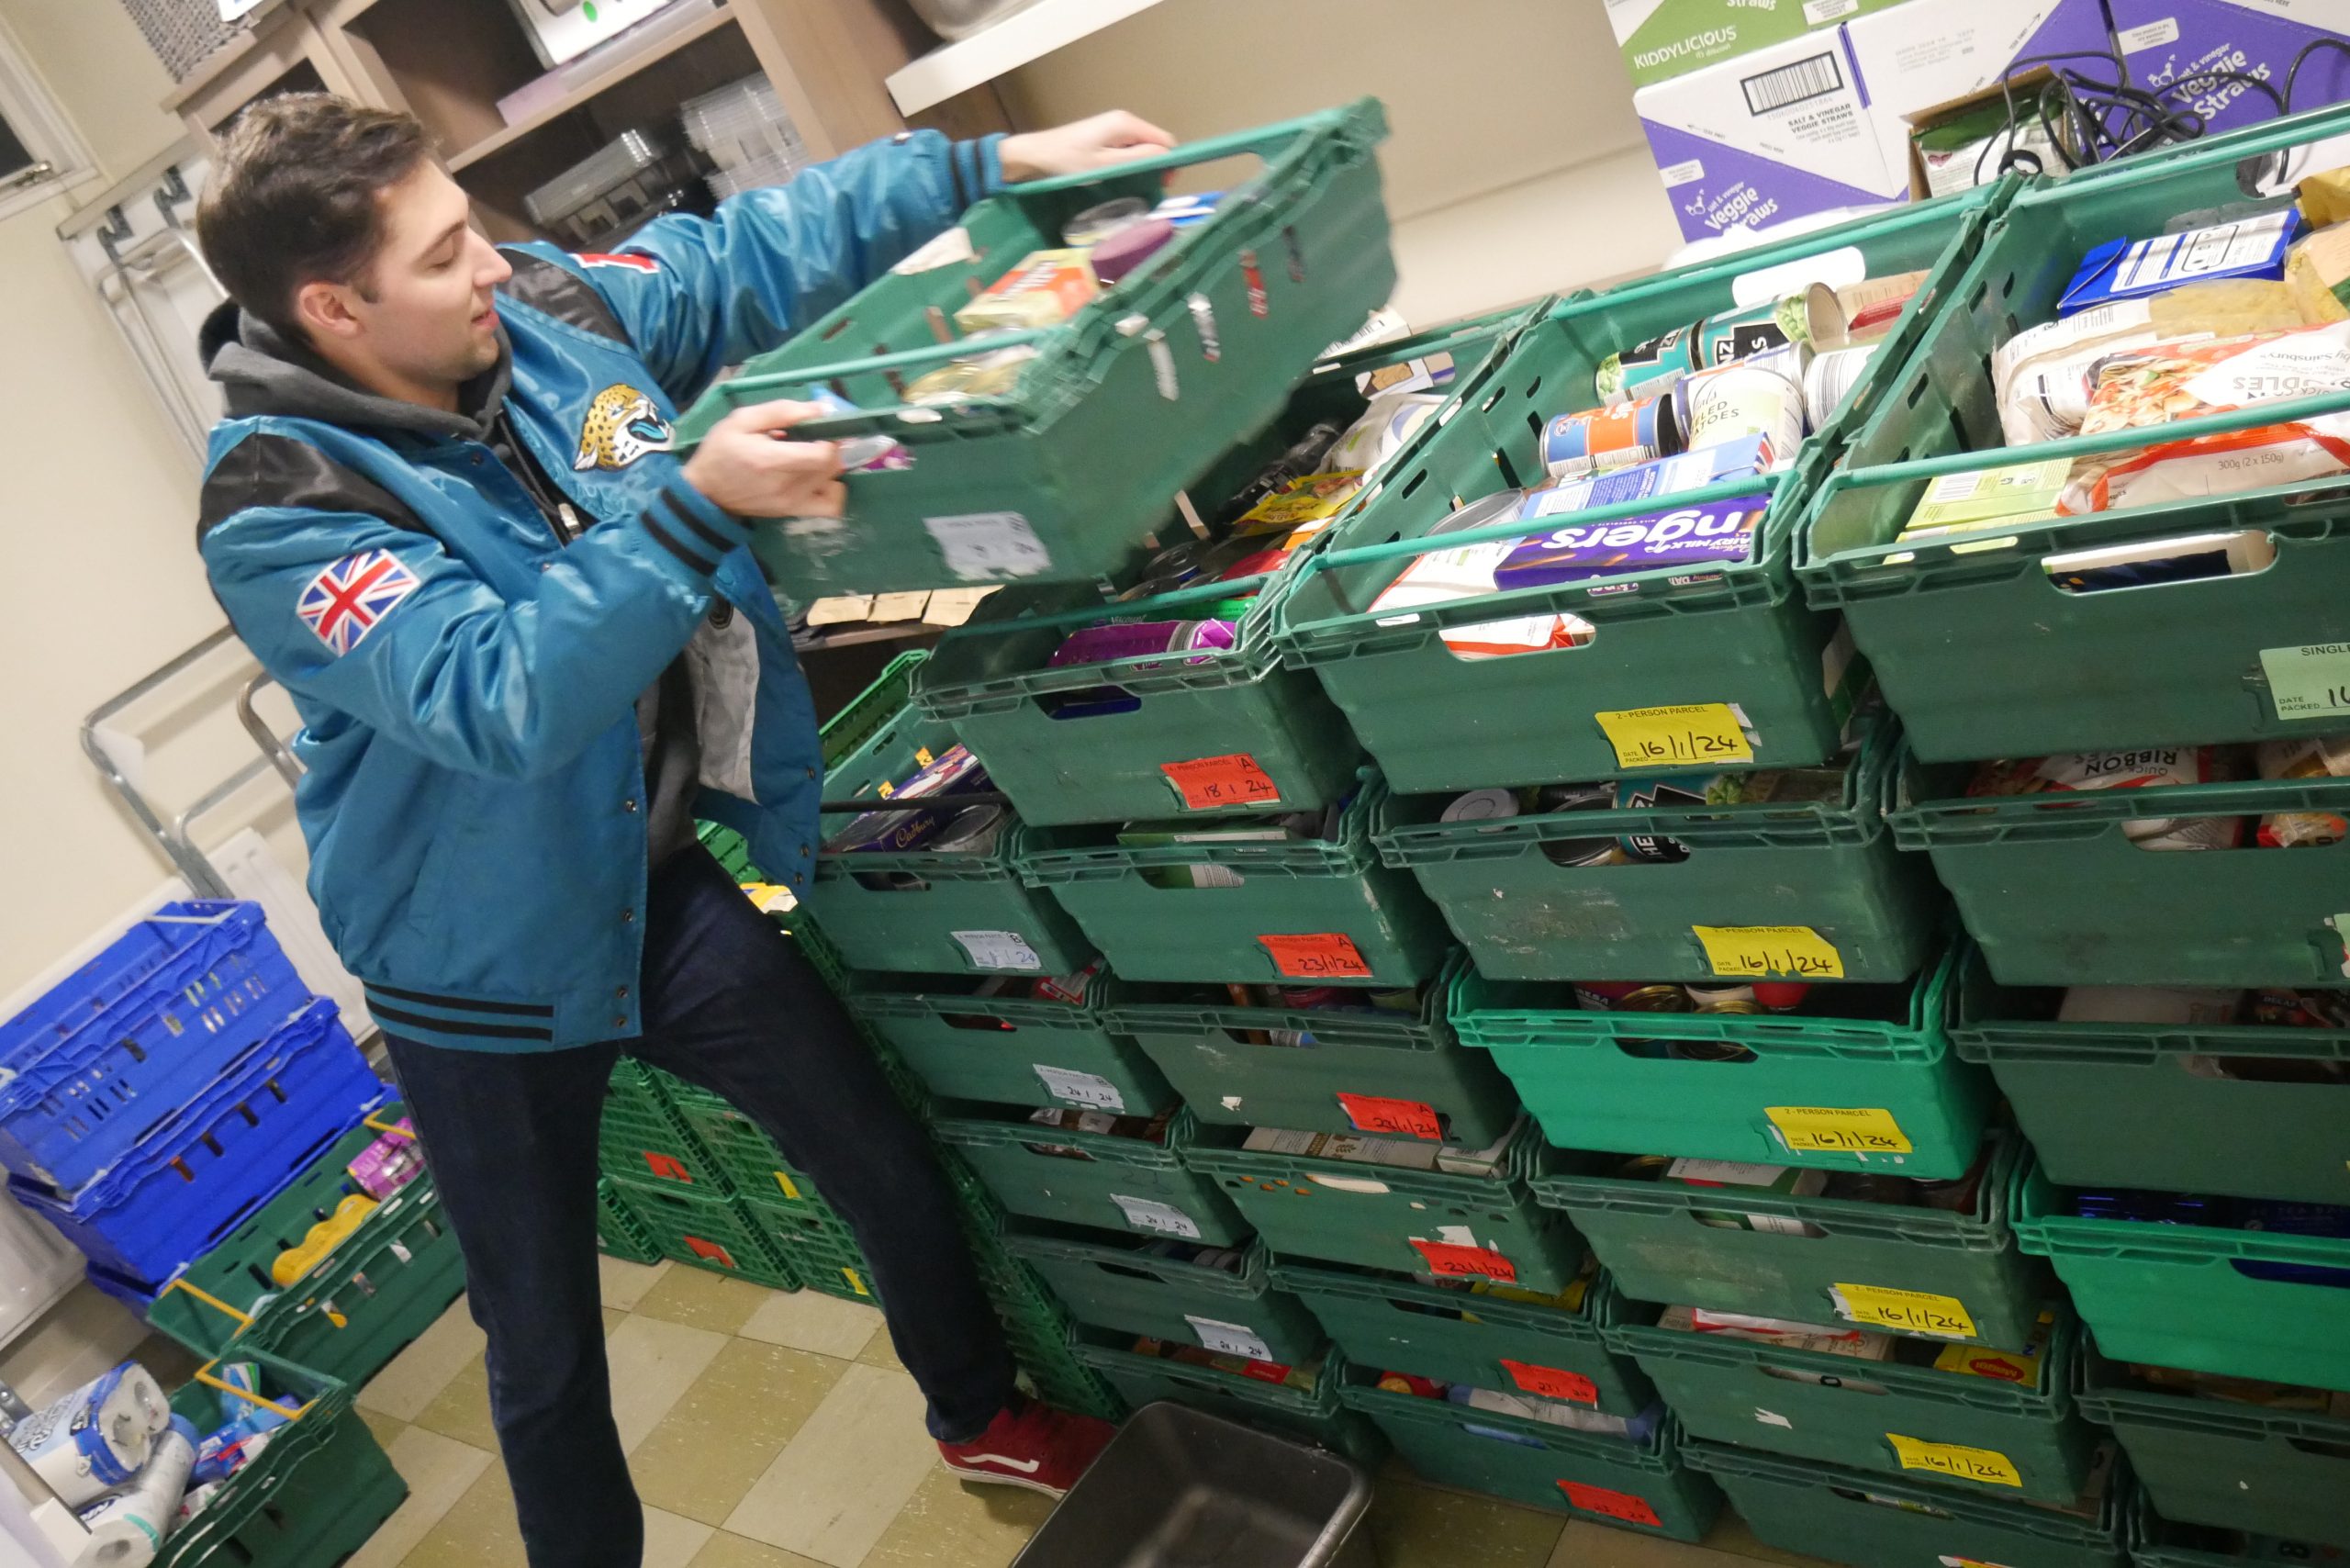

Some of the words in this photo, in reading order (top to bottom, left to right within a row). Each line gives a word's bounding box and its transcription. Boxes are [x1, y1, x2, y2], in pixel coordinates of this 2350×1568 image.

[1634, 26, 1737, 69] KIDDYLICIOUS
[2199, 43, 2230, 65] vinegar
[1788, 116, 1807, 128] SALT
[1816, 103, 1852, 118] VINEGAR
[1791, 121, 1821, 133] VEGGIE
[1821, 110, 1854, 125] STRAWS
[1704, 187, 1760, 230] Veggie
[2218, 459, 2241, 471] 300g
[2242, 456, 2251, 467] (2
[2260, 452, 2285, 464] 150g)
[1541, 509, 1743, 550] ngers
[1672, 540, 1708, 550] MILK
[1707, 537, 1751, 549] AIRY
[2278, 696, 2305, 705] DATE
[2281, 702, 2321, 712] PACKED
[1628, 708, 1668, 719] PERSON
[1669, 706, 1709, 715] PARCEL
[1639, 731, 1739, 760] 16/1/24
[1239, 756, 1252, 769] A
[2084, 749, 2177, 777] RIBBON
[1203, 783, 1222, 799] 18
[1245, 779, 1272, 795] 24
[896, 815, 936, 848] Cadbury
[1338, 936, 1351, 947] A
[1015, 950, 1036, 964] 24
[1297, 954, 1365, 973] 23/1/24
[1740, 948, 1834, 974] 16/1/24
[1099, 1092, 1113, 1102] 24
[1811, 1130, 1899, 1148] 16/1/24
[1175, 1221, 1188, 1231] 24
[1865, 1287, 1903, 1297] PERSON
[1904, 1291, 1941, 1302] PARCEL
[1877, 1306, 1969, 1331] 16/1/24
[1248, 1346, 1263, 1357] 24
